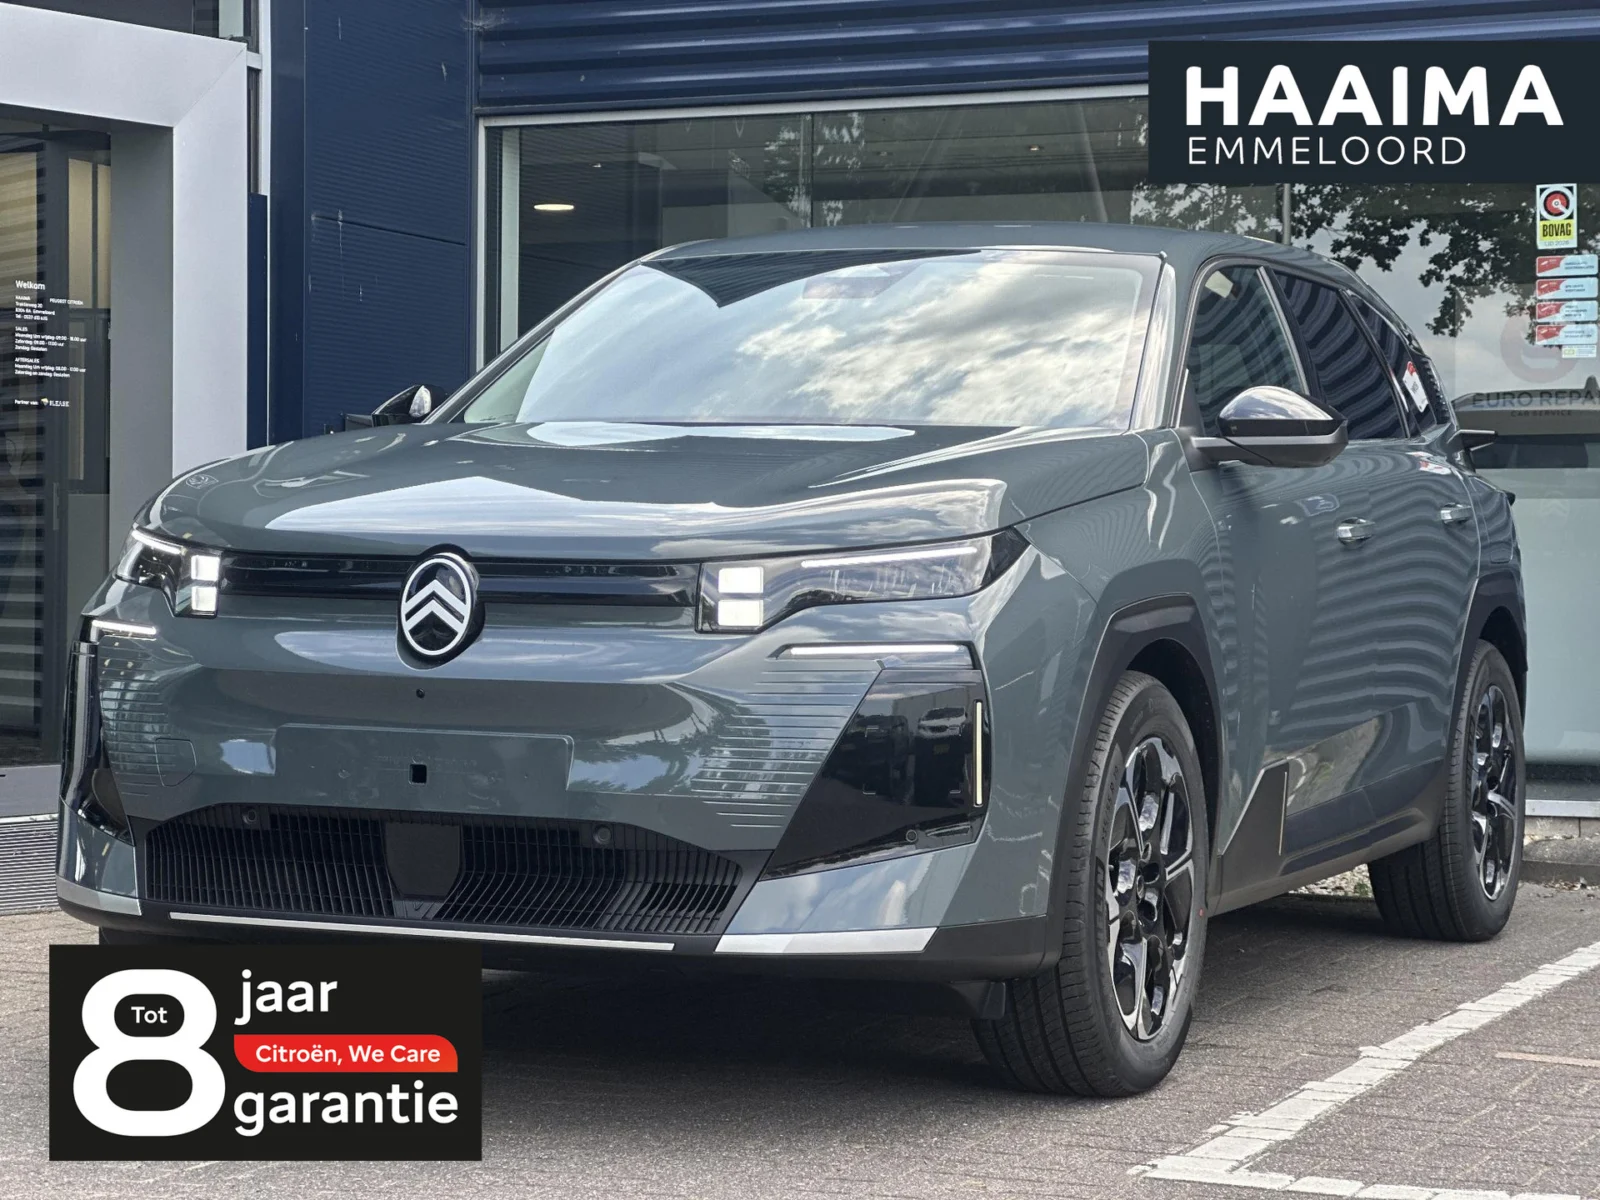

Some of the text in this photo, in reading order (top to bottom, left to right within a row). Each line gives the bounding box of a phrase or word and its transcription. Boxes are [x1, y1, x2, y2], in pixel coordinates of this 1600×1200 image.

[1542, 222, 1572, 238] BOVAG
[15, 280, 46, 290] Welkom
[1472, 391, 1534, 408] EURO
[1532, 409, 1572, 417] SERVICE
